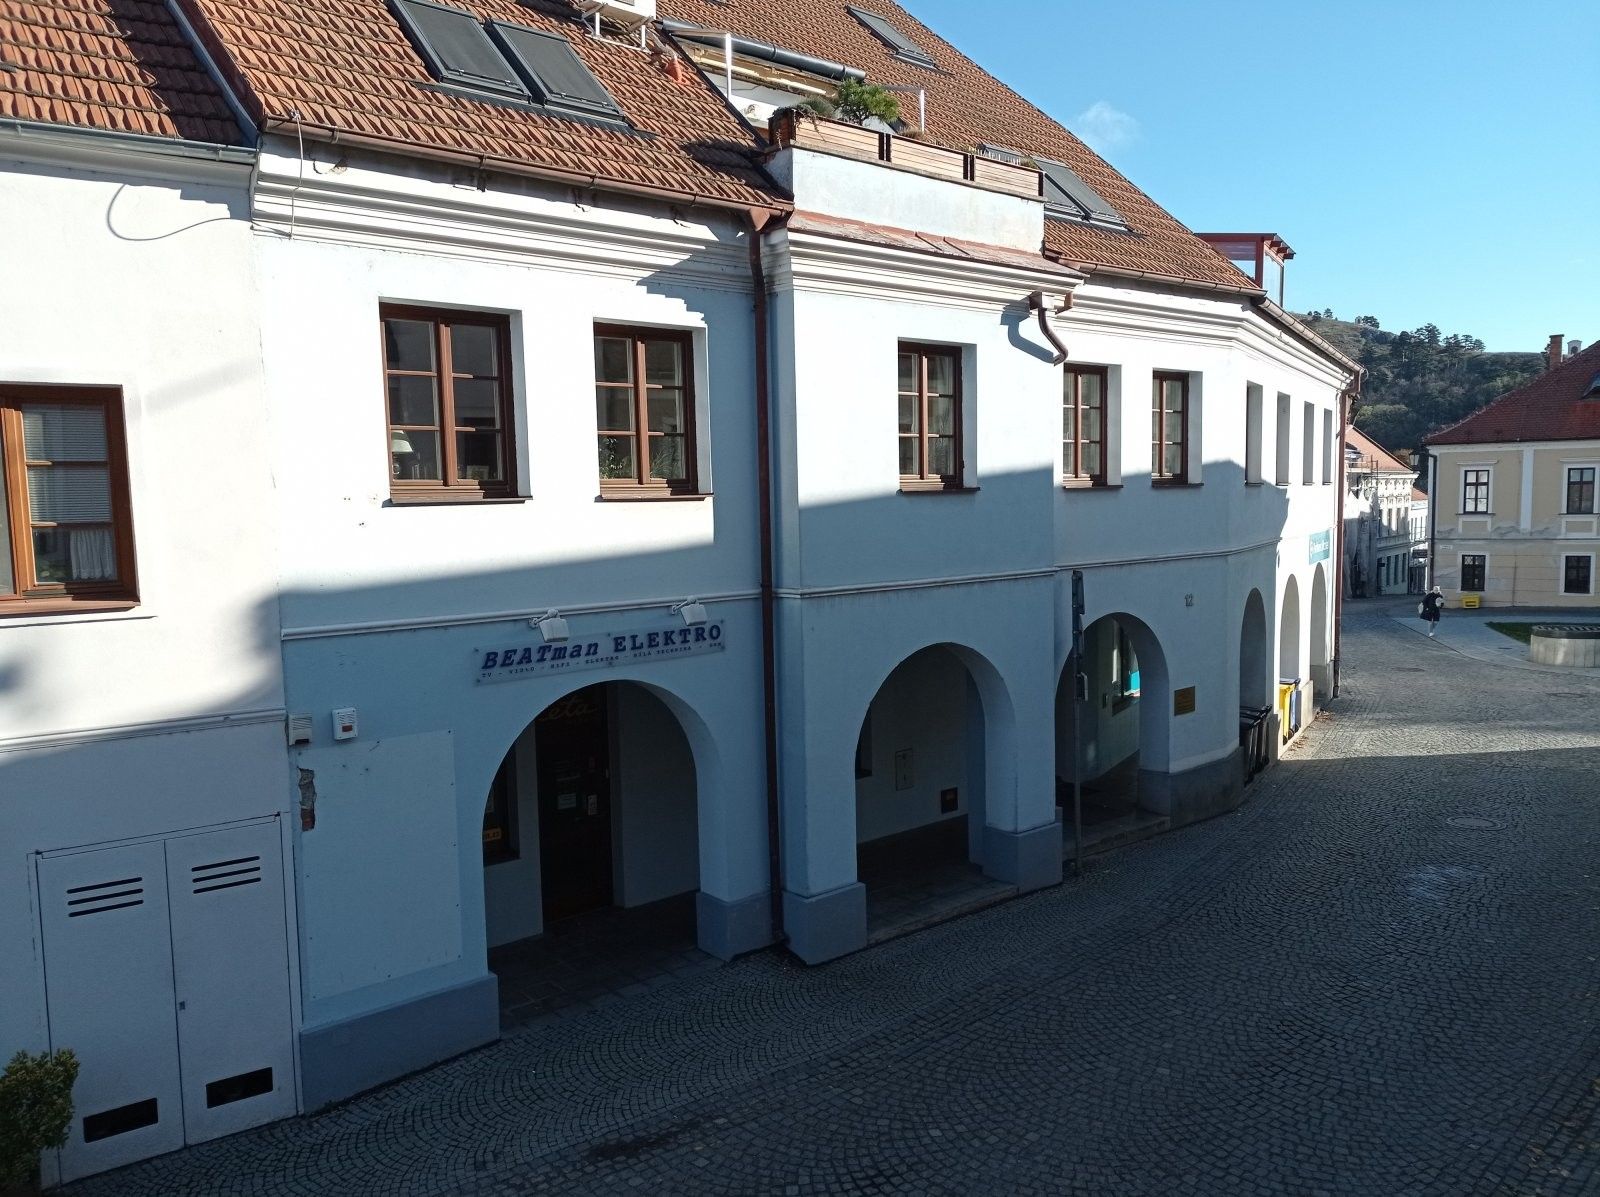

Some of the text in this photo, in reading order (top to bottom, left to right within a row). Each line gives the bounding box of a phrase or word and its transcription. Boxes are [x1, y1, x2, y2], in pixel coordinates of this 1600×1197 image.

[481, 624, 721, 670] BEATman ELEKTRO
[508, 666, 535, 674] VIDEO
